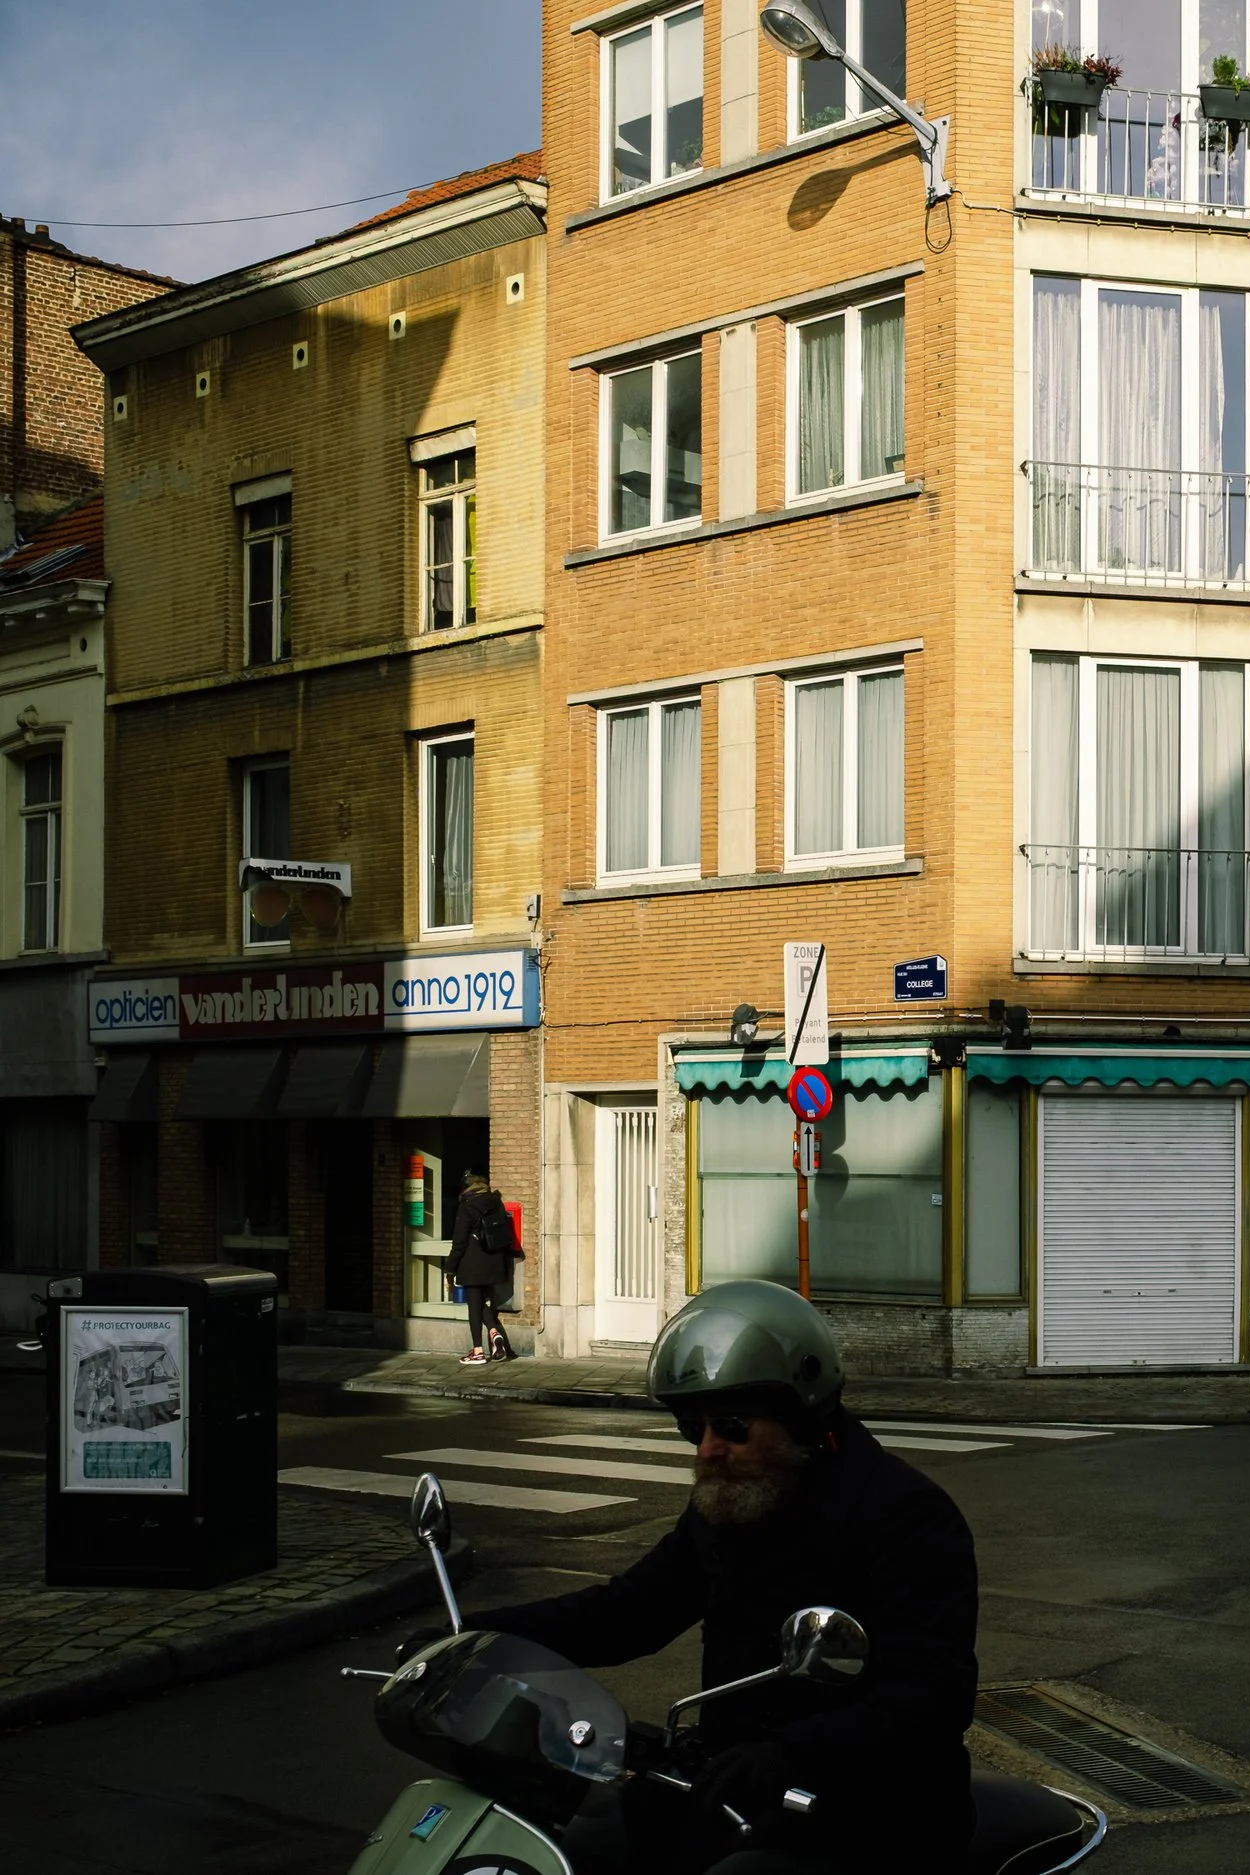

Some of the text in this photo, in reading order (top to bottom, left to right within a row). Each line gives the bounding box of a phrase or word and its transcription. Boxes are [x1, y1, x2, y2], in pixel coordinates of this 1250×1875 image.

[793, 946, 820, 959] ZONE
[800, 966, 814, 993] P
[906, 979, 934, 989] COLLEGE
[95, 970, 516, 1029] opticien vanderlinden anno 1919
[795, 1018, 821, 1030] Pyant
[792, 1034, 826, 1044] Btalend
[81, 1319, 171, 1331] #PROTECTYOURBAG
